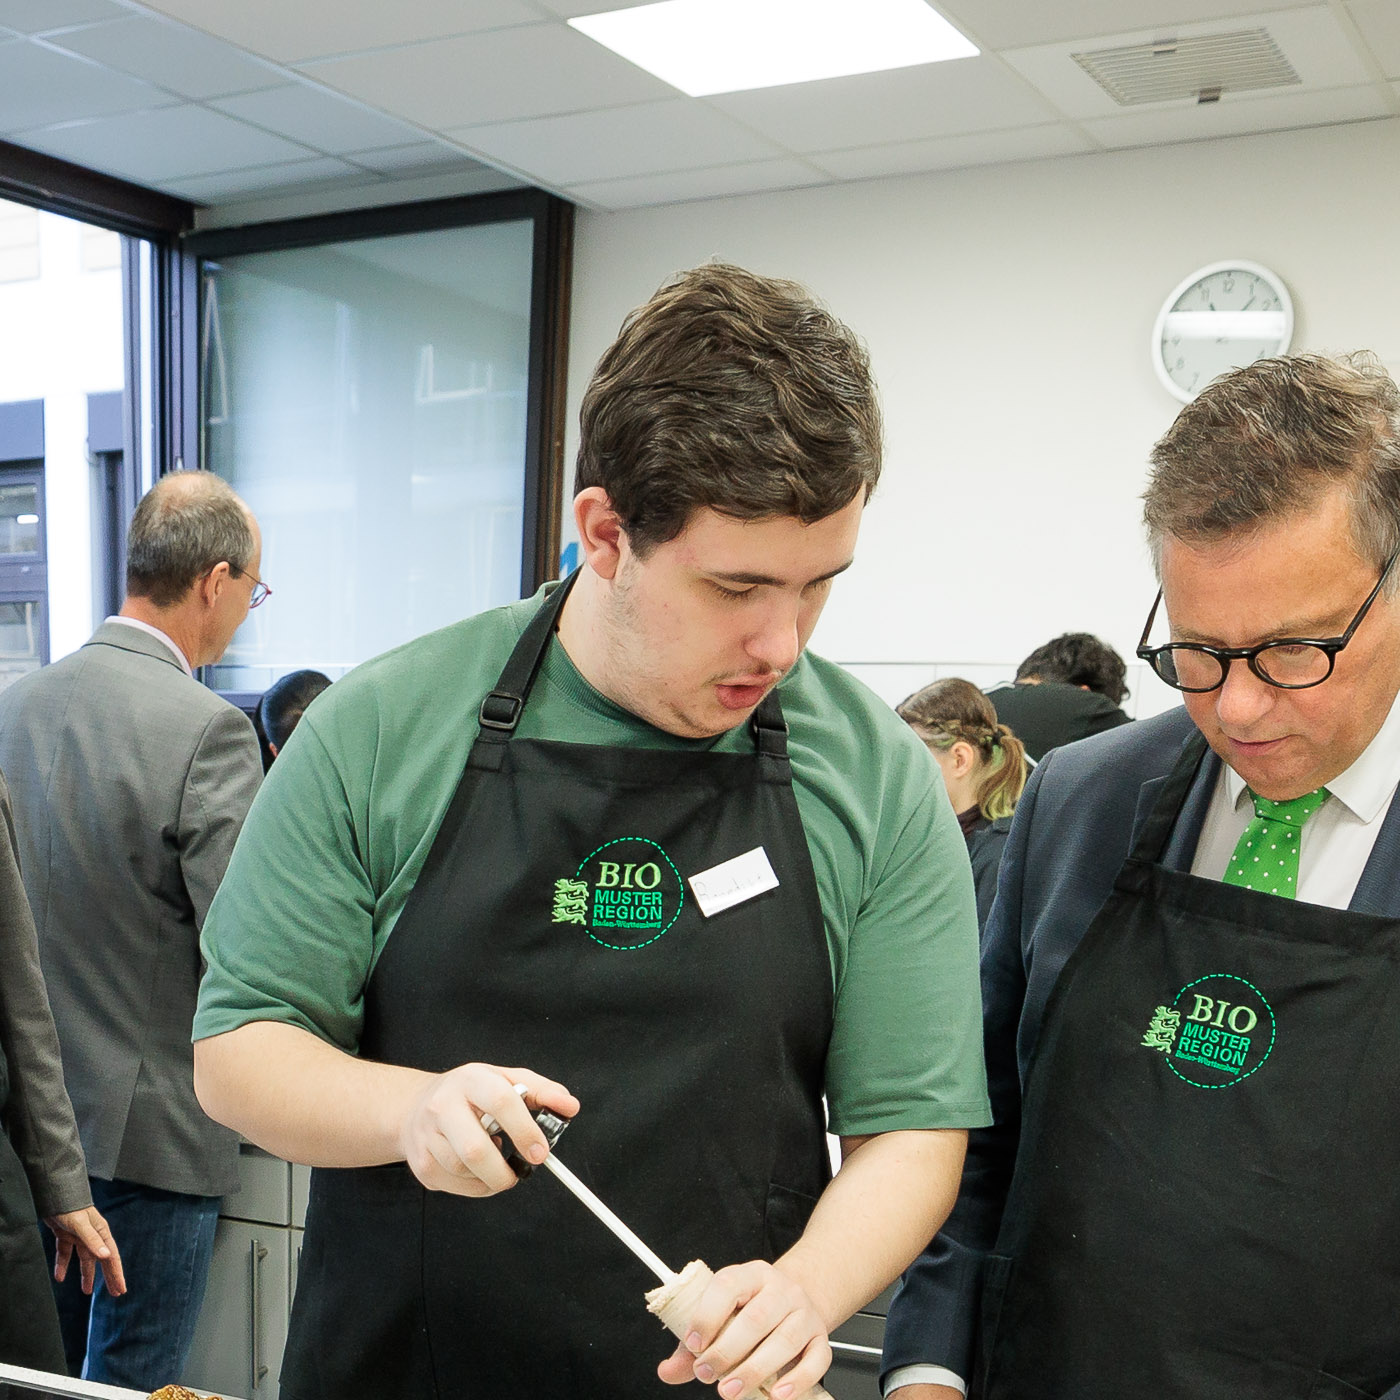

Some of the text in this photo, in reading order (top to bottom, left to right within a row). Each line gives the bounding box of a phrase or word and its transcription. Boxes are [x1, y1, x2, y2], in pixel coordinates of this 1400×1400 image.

[595, 861, 662, 890] BIO
[595, 889, 663, 905] MUSTER
[593, 904, 663, 920] REGION
[1186, 993, 1258, 1034] BIO
[1178, 1036, 1247, 1067] REGION
[1183, 1022, 1251, 1052] MUSTER
